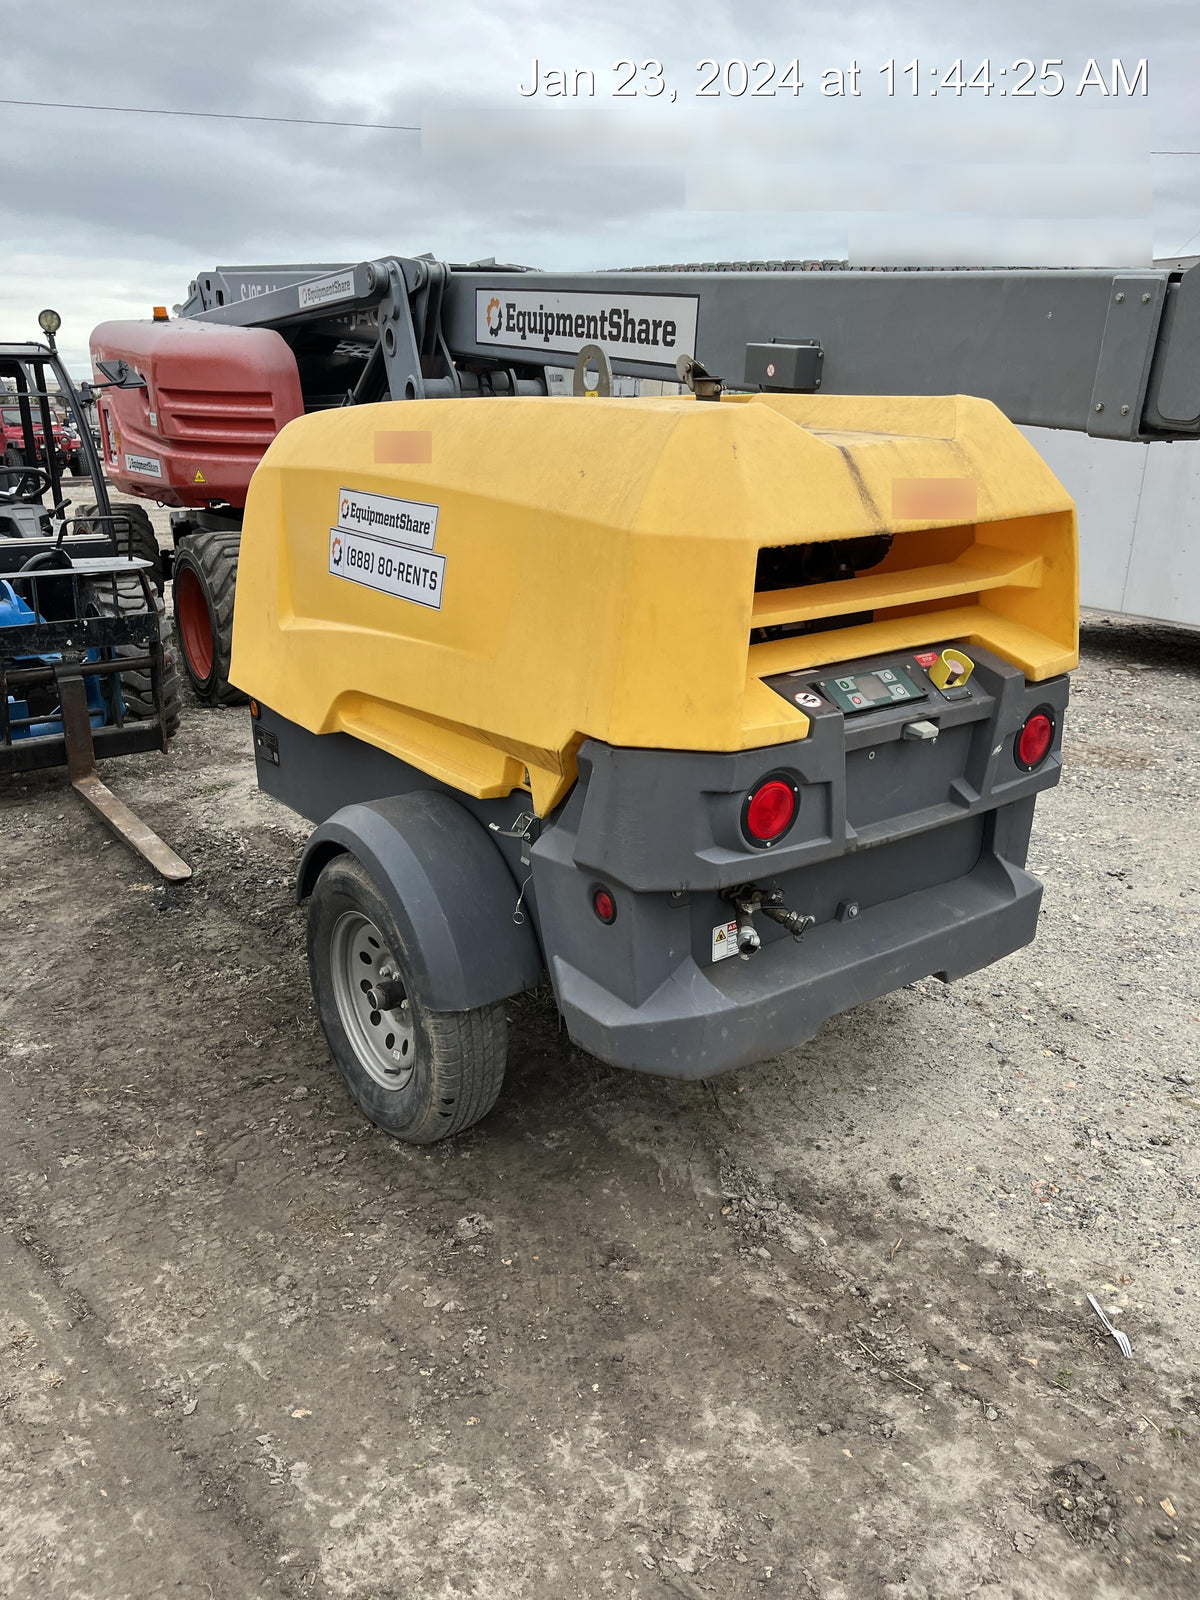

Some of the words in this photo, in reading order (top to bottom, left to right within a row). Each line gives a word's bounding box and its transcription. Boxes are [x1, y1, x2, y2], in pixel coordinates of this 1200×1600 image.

[307, 279, 351, 303] EquipmentShare
[505, 302, 677, 348] EquipmentShare
[350, 502, 431, 535] EquipmentShare
[346, 545, 375, 574] (888)
[377, 556, 438, 591] 80-RENTS
